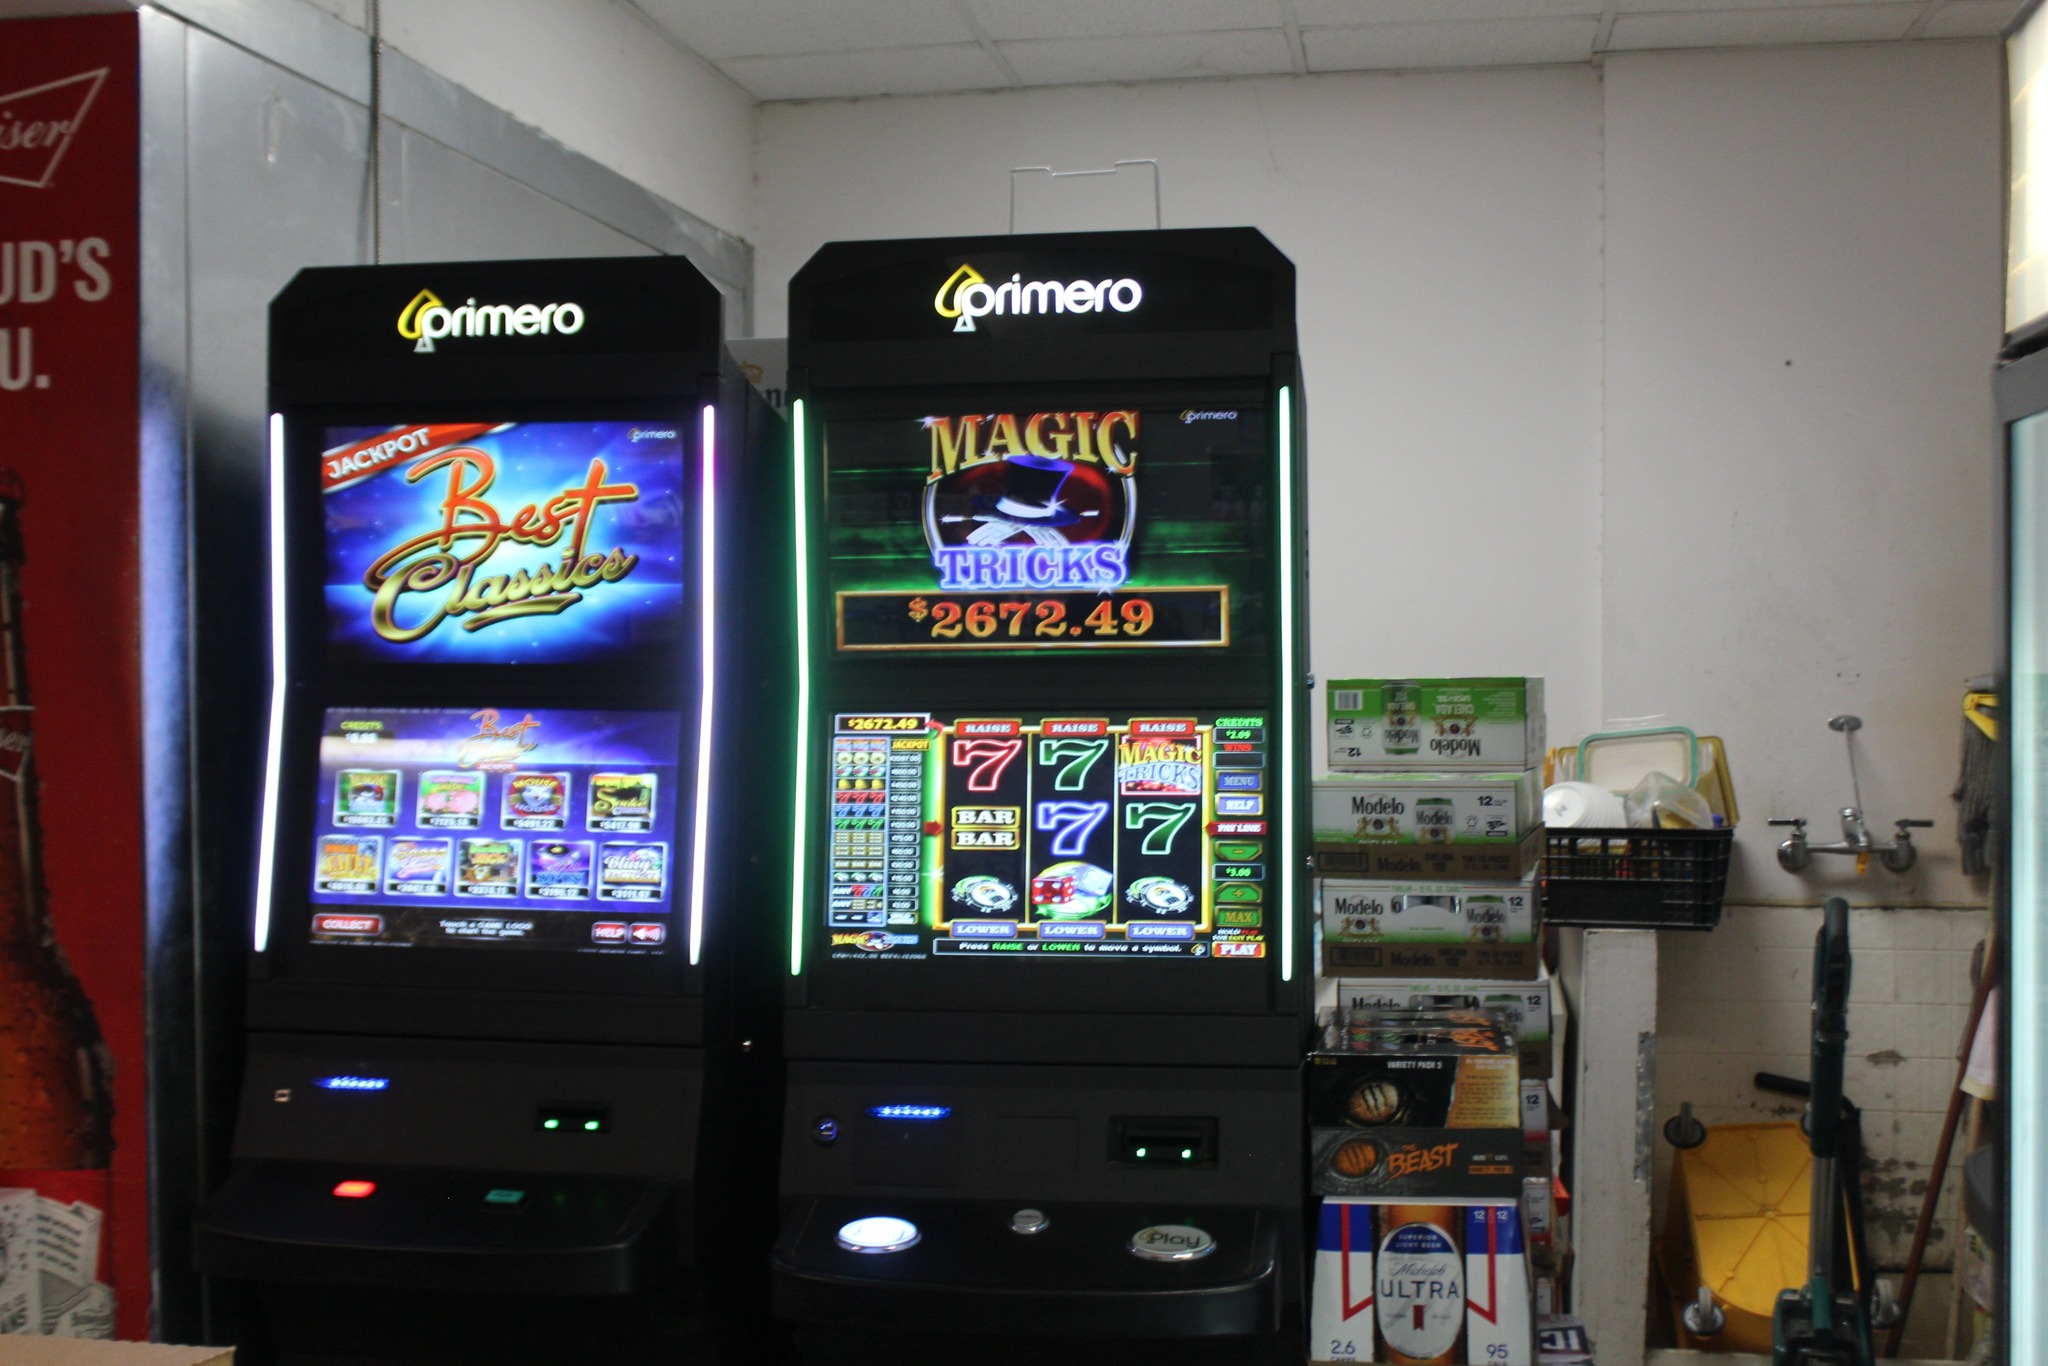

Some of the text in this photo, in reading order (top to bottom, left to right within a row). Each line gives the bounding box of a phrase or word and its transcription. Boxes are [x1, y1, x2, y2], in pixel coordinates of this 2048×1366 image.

[953, 273, 1142, 332] primero
[413, 296, 585, 353] primero
[1183, 410, 1238, 424] primero
[629, 428, 676, 442] primero
[327, 427, 430, 479] JACKPOT
[925, 410, 1140, 483] MAGIC
[368, 446, 639, 590] Best
[933, 543, 1130, 591] TRICKS
[371, 547, 639, 642] Classics
[908, 597, 1154, 637] $2672.49
[848, 718, 918, 730] $2672.49
[965, 723, 1011, 733] RAISE
[1051, 723, 1098, 733] RAISE
[1138, 722, 1186, 733] RAISE
[1215, 717, 1263, 727] CREDITS
[891, 740, 929, 749] JACKPOT
[1430, 738, 1480, 756] Modelo
[1119, 742, 1202, 766] MAGIC
[953, 739, 1023, 791] 7
[1039, 739, 1109, 791] 7
[1118, 764, 1202, 792] TRICKS
[1224, 776, 1255, 786] MENU
[1225, 800, 1255, 810] HELP
[1352, 796, 1405, 815] Modelo
[1478, 796, 1493, 806] 12
[957, 810, 1015, 825] BAR
[1036, 801, 1110, 855] 7
[1125, 802, 1197, 855] 7
[957, 832, 1015, 846] BAR
[604, 855, 654, 873] Bling
[1334, 898, 1384, 915] Modelo
[1509, 896, 1523, 907] 12
[1225, 911, 1253, 923] MAX
[322, 919, 373, 930] COLLECT
[956, 924, 1012, 935] LOWER
[1043, 925, 1098, 936] LOWER
[1132, 926, 1188, 936] LOWER
[595, 927, 625, 938] HELP
[991, 943, 1024, 951] RAISE
[1042, 943, 1080, 951] LOWER
[1220, 944, 1257, 955] PLAY
[1526, 995, 1541, 1006] 12
[1526, 1095, 1540, 1105] 12
[1388, 1143, 1459, 1179] BEAST
[1473, 1210, 1486, 1220] 12
[1496, 1210, 1508, 1220] 12
[1147, 1232, 1200, 1249] Play
[1381, 1280, 1460, 1299] ULTRA
[1330, 1339, 1356, 1355] 2.6
[1486, 1344, 1508, 1359] 95
